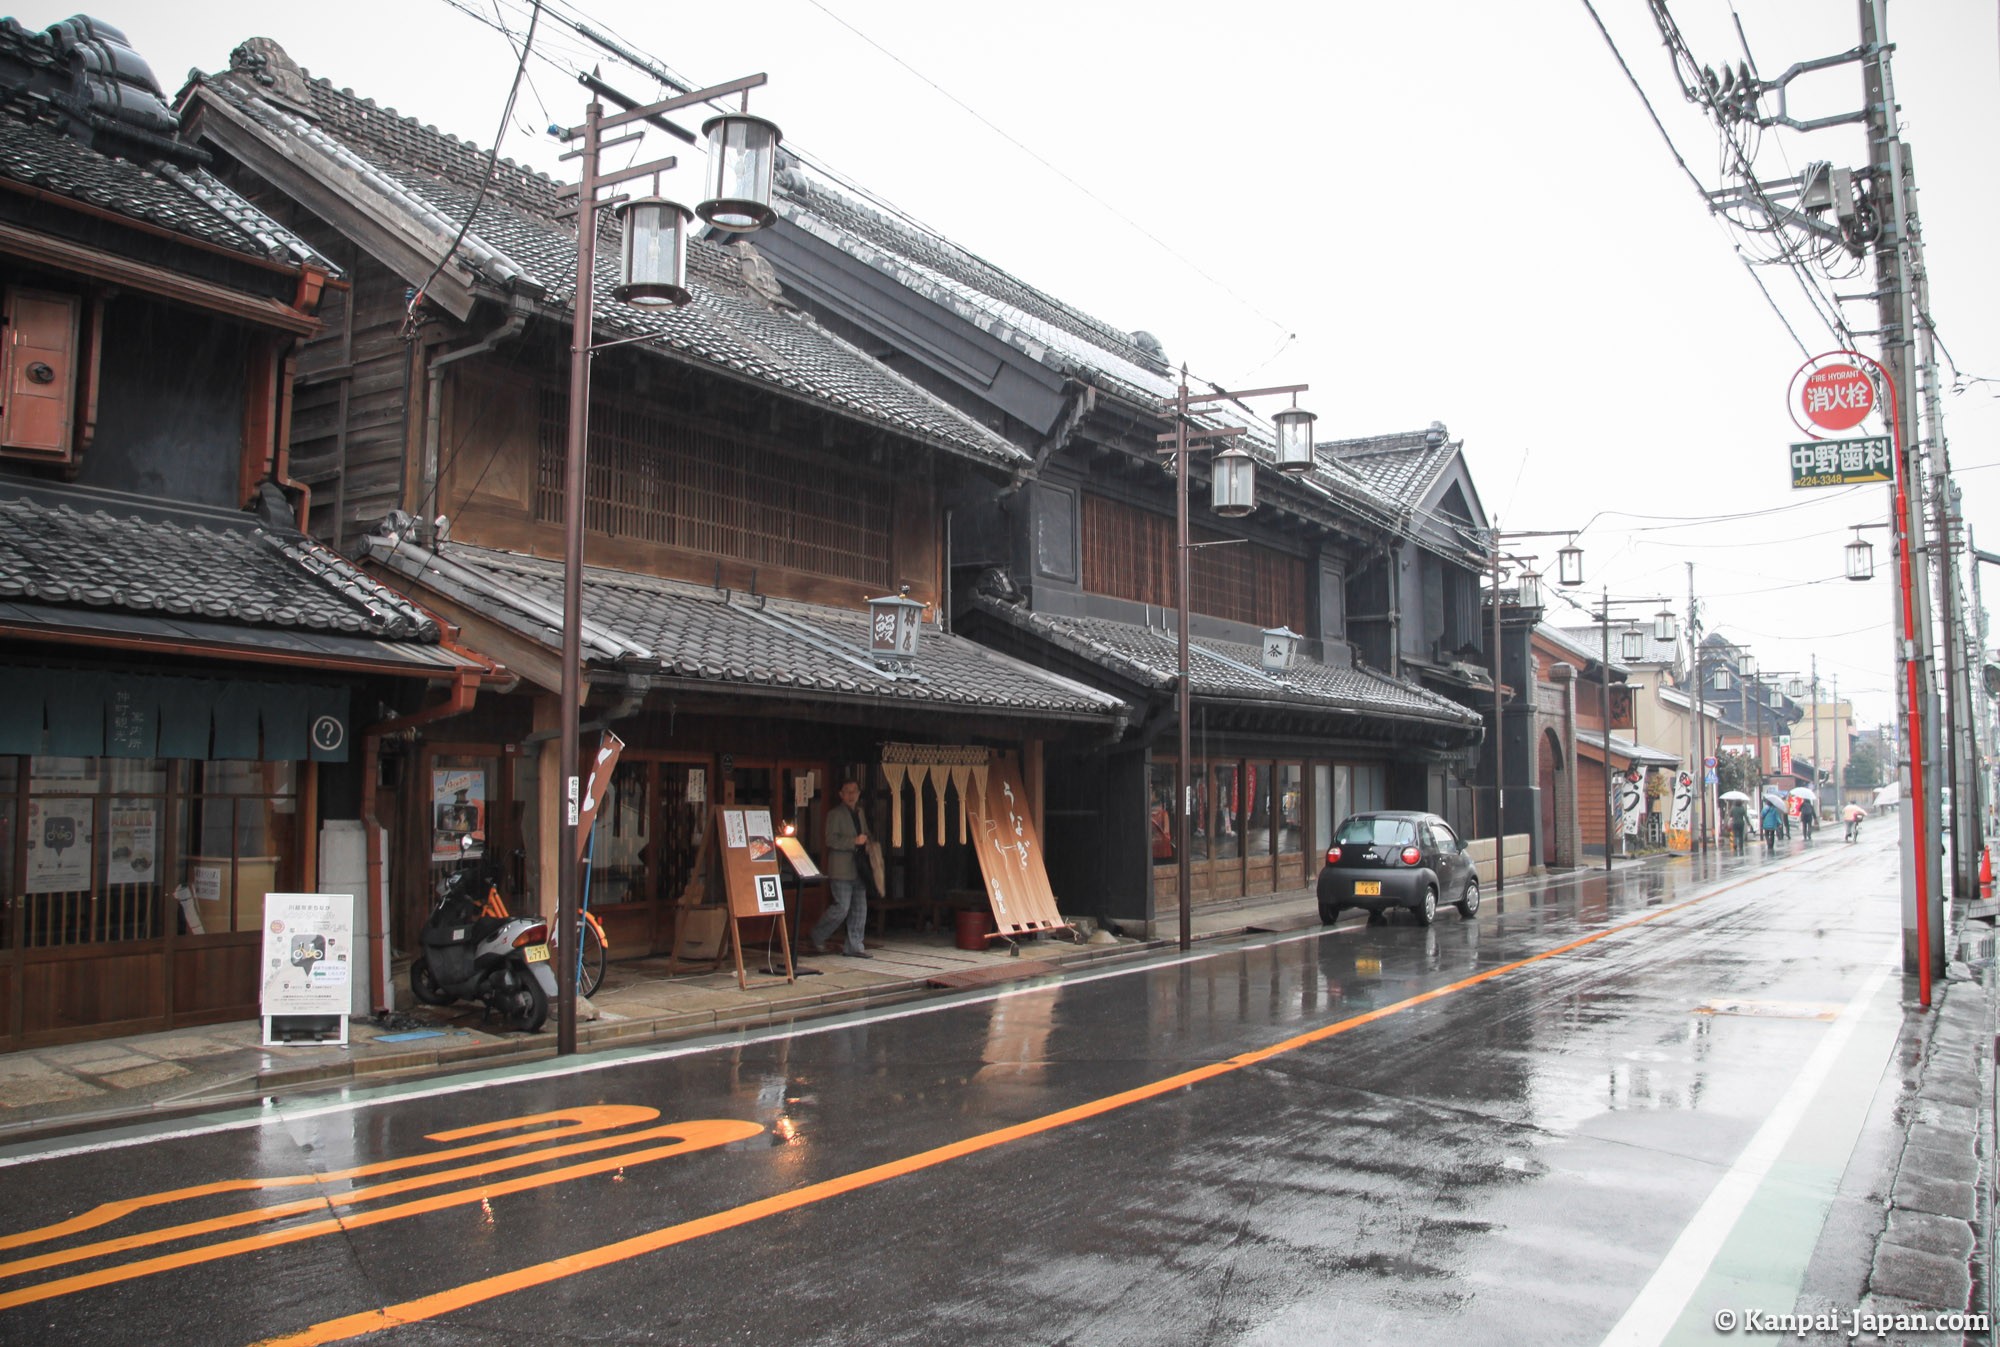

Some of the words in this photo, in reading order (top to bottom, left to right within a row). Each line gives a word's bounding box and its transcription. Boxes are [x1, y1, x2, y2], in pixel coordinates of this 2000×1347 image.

[1811, 374, 1826, 383] FIRE
[1828, 370, 1860, 381] HYDRANT
[1807, 381, 1869, 413] 消火栓
[1791, 439, 1890, 476] 中野歯科
[1800, 473, 1842, 487] 224-3348
[1267, 643, 1283, 658] 茶
[1003, 780, 1031, 871] うなぎ
